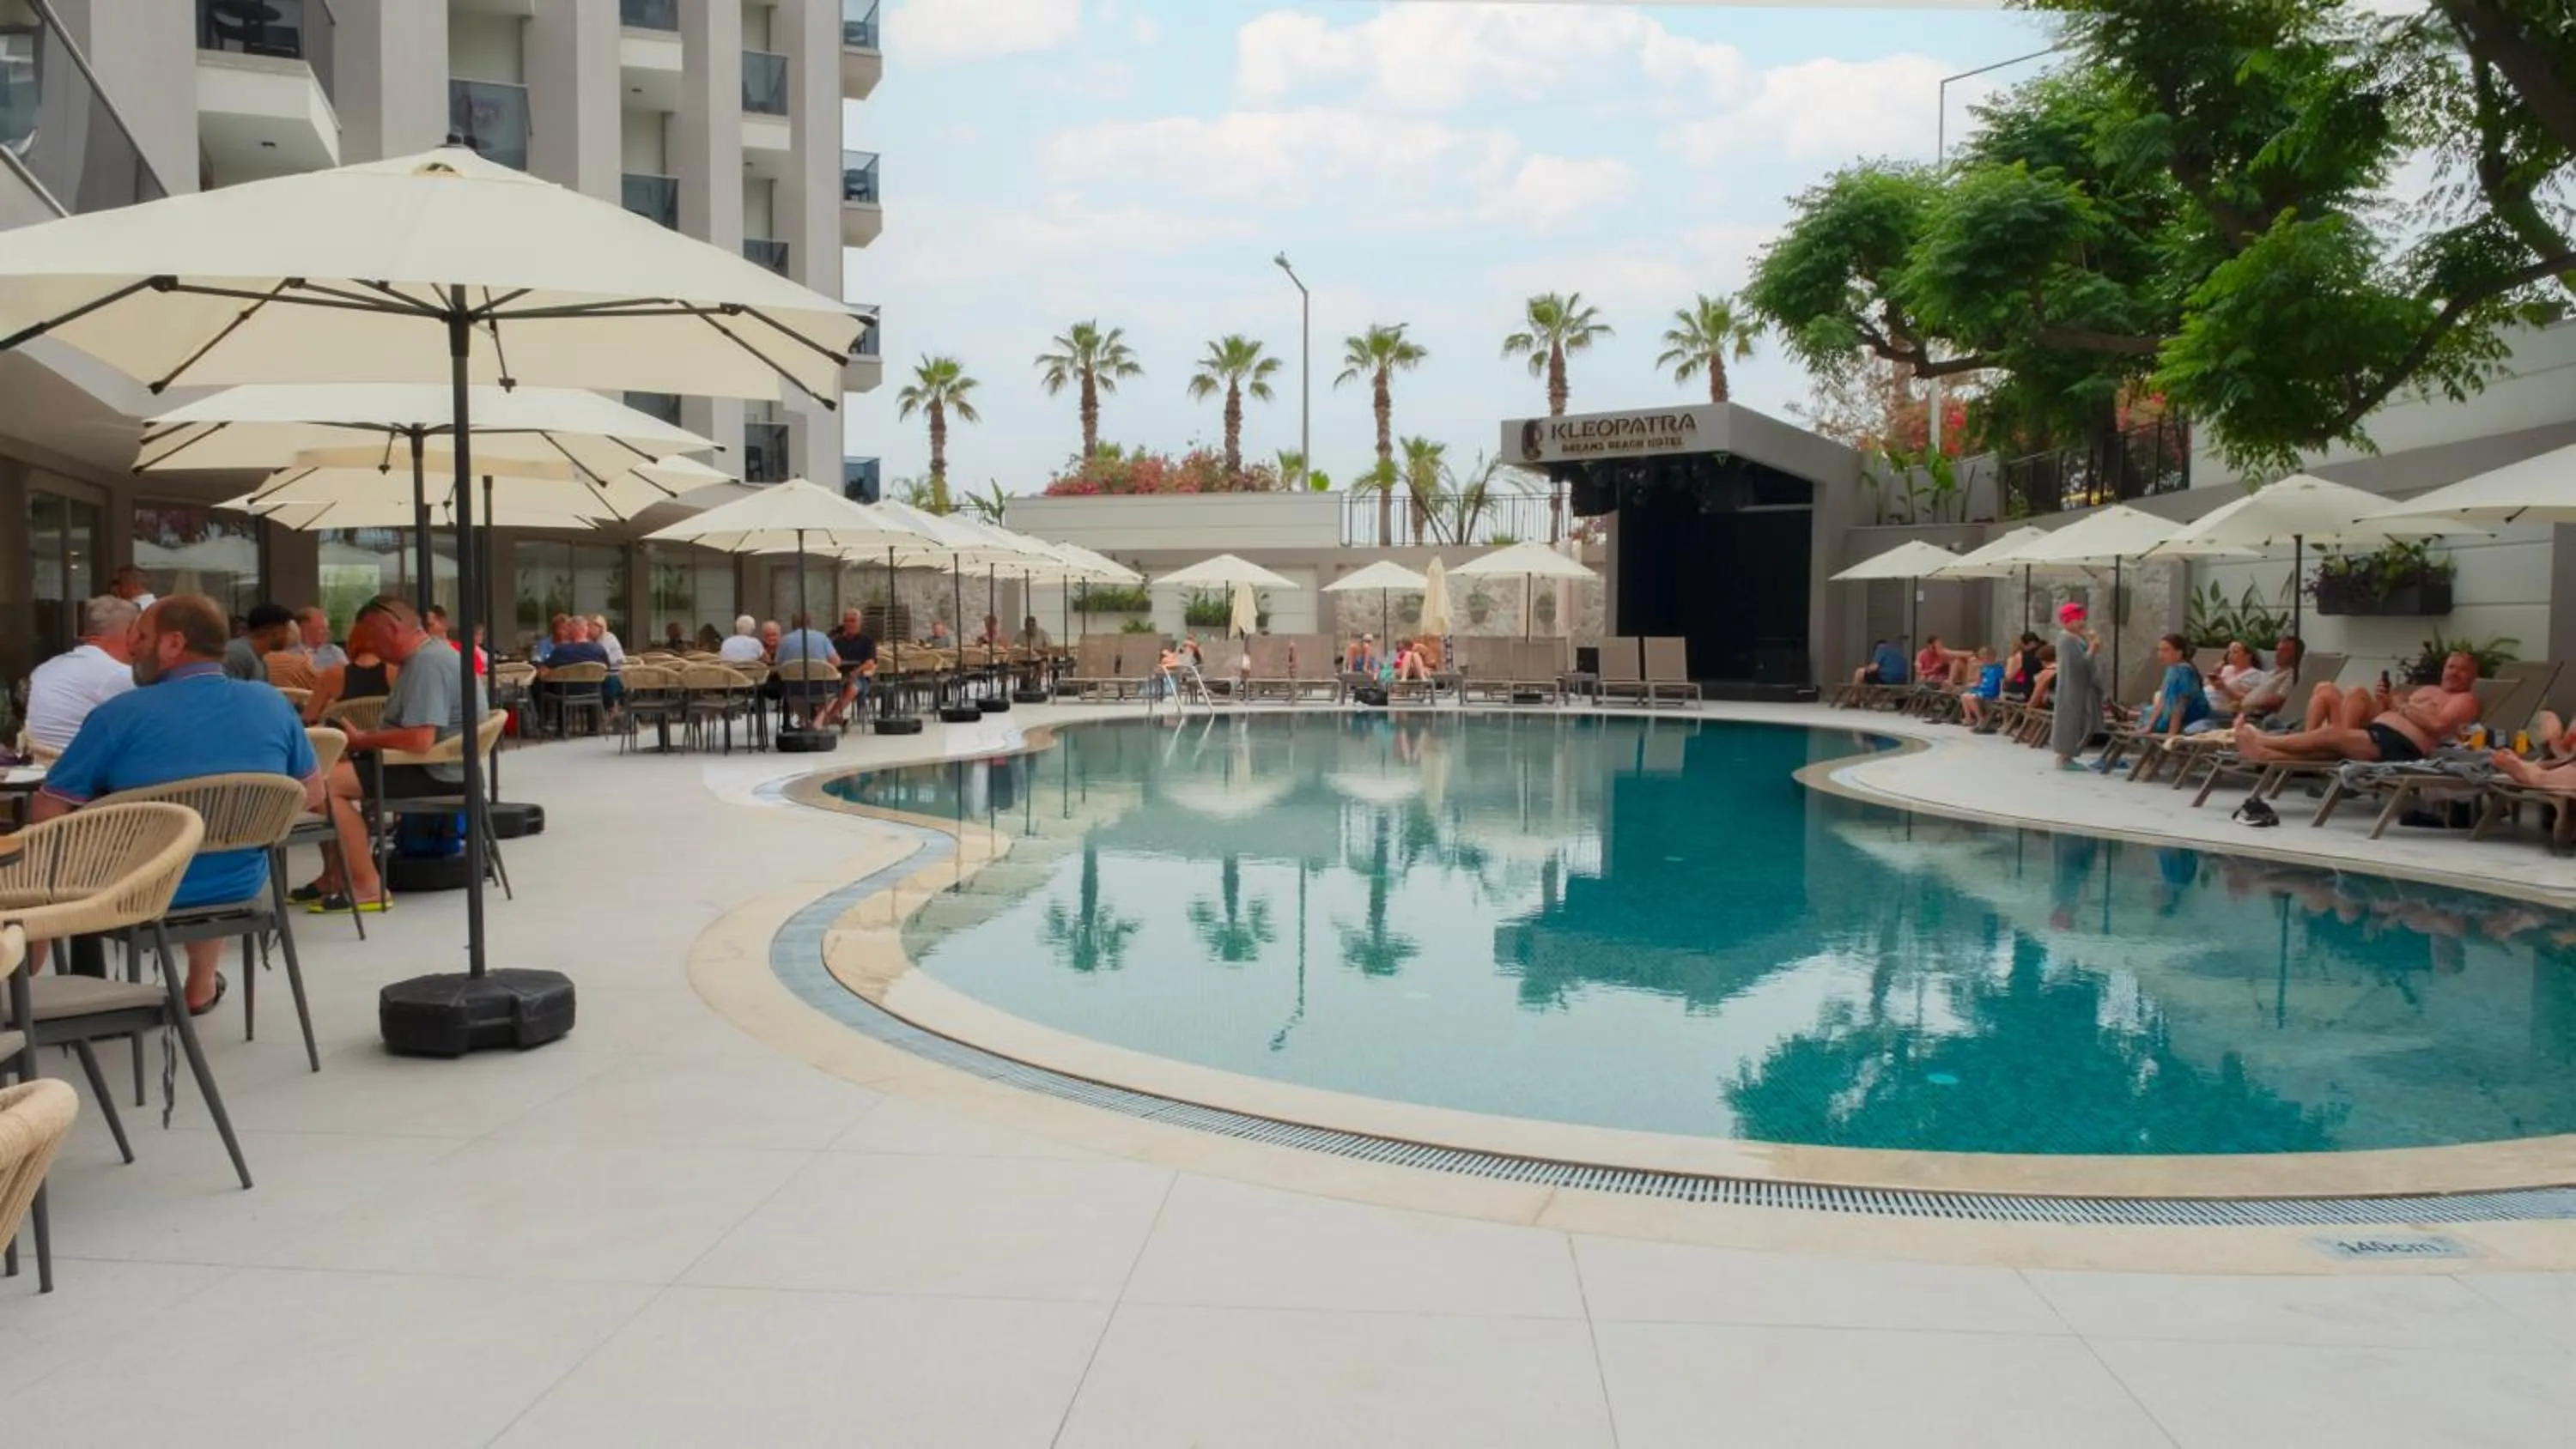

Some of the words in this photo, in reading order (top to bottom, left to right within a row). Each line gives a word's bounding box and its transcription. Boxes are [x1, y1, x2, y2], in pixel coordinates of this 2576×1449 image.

[1551, 413, 1698, 440] KLEOPATRA
[1561, 442, 1605, 454] DREAMS
[1608, 440, 1644, 452] BEACH
[1648, 436, 1684, 449] HOTEL
